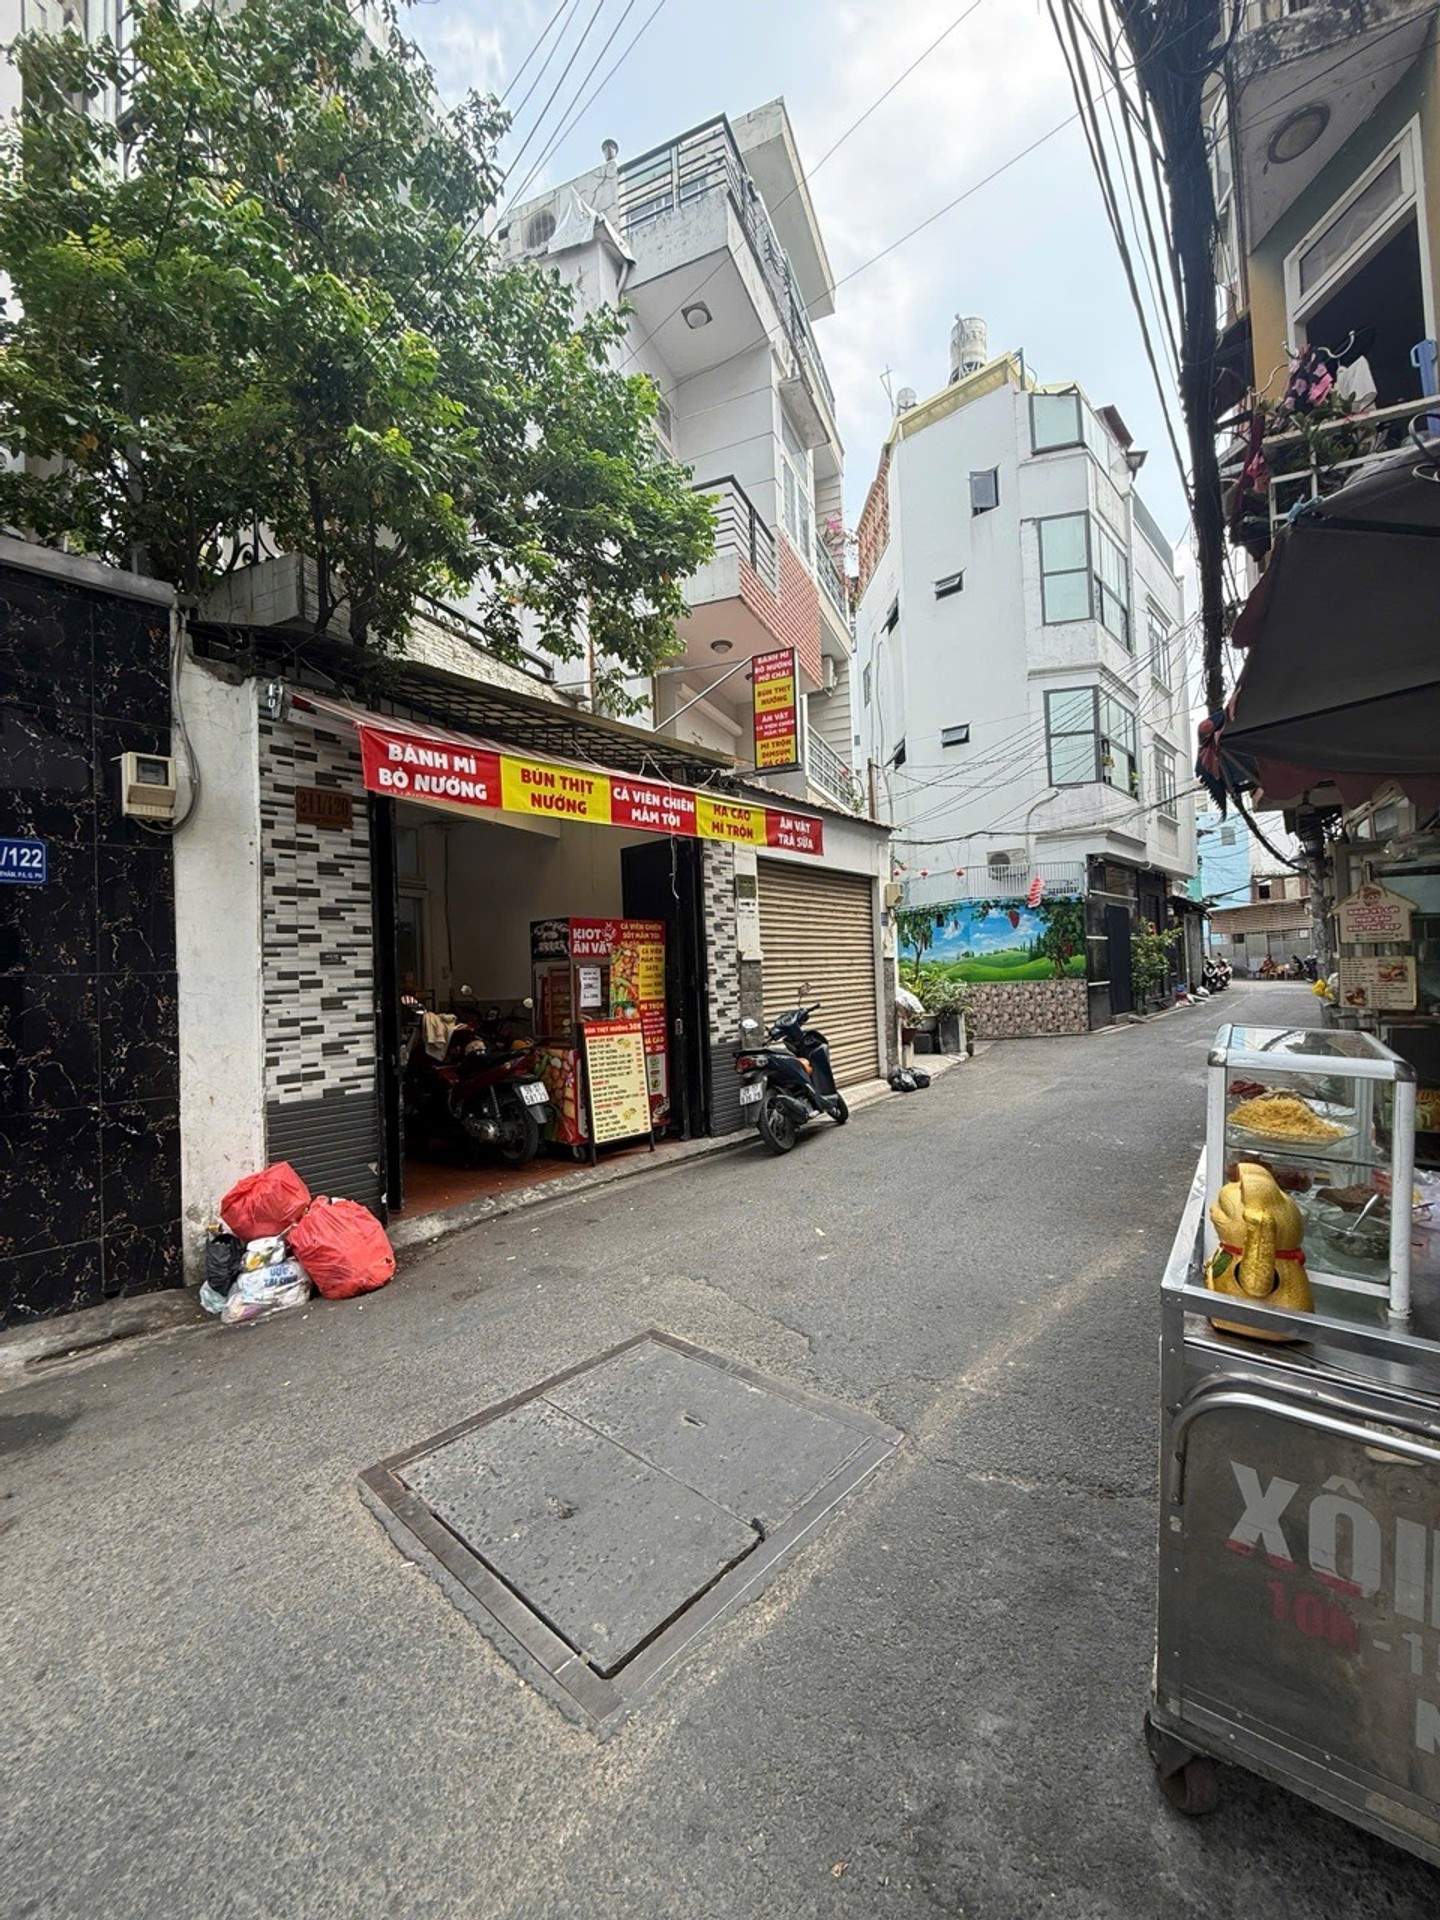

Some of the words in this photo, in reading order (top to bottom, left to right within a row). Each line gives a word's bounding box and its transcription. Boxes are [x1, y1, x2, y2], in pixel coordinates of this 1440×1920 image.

[388, 743, 448, 770] BÁNH
[378, 767, 408, 788] BÒ
[414, 774, 487, 800] NƯỚNG
[521, 768, 555, 788] BÚN
[560, 776, 594, 797] THỊT
[531, 793, 587, 815] NƯỚNG
[613, 786, 629, 801] CÁ
[632, 790, 660, 807] VIÊN
[662, 794, 694, 812] CHIÊN
[0, 846, 42, 868] /122
[573, 928, 601, 940] KIOT
[573, 941, 589, 953] ĂN
[591, 941, 613, 954] VẶT
